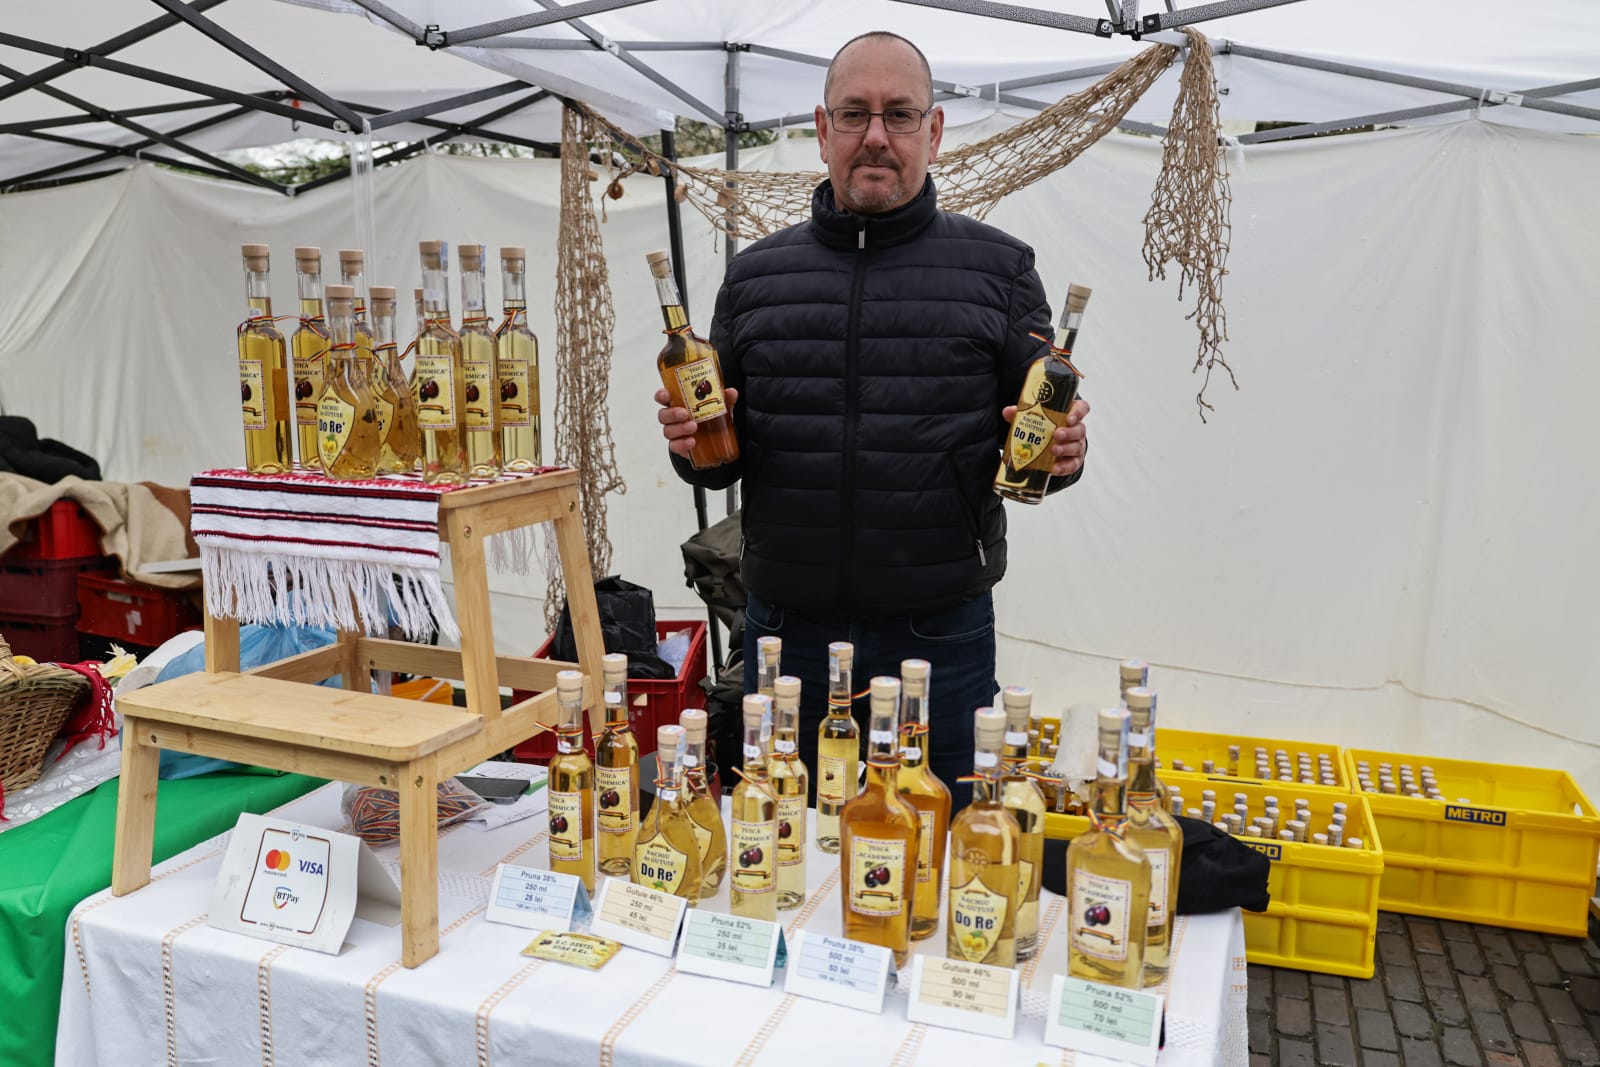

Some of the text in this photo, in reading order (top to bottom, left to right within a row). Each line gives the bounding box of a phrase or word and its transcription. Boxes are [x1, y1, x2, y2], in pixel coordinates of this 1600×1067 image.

[1013, 426, 1026, 441] Do
[1448, 807, 1504, 824] METRO
[297, 858, 324, 876] VISA
[641, 862, 655, 878] Do
[521, 870, 541, 880] Pruna
[524, 882, 548, 893] 250 ml
[524, 893, 543, 903] 25 lei
[630, 899, 653, 912] 250 ml
[629, 911, 647, 922] 45 lei
[711, 916, 734, 928] Pruna
[955, 909, 971, 927] Do
[727, 943, 738, 953] lei
[822, 937, 846, 949] Pruna
[828, 951, 843, 961] 500
[839, 966, 850, 975] lei
[951, 976, 966, 986] 500
[964, 991, 976, 1001] lei
[1085, 984, 1112, 998] Pruna
[1106, 1015, 1118, 1026] lei
